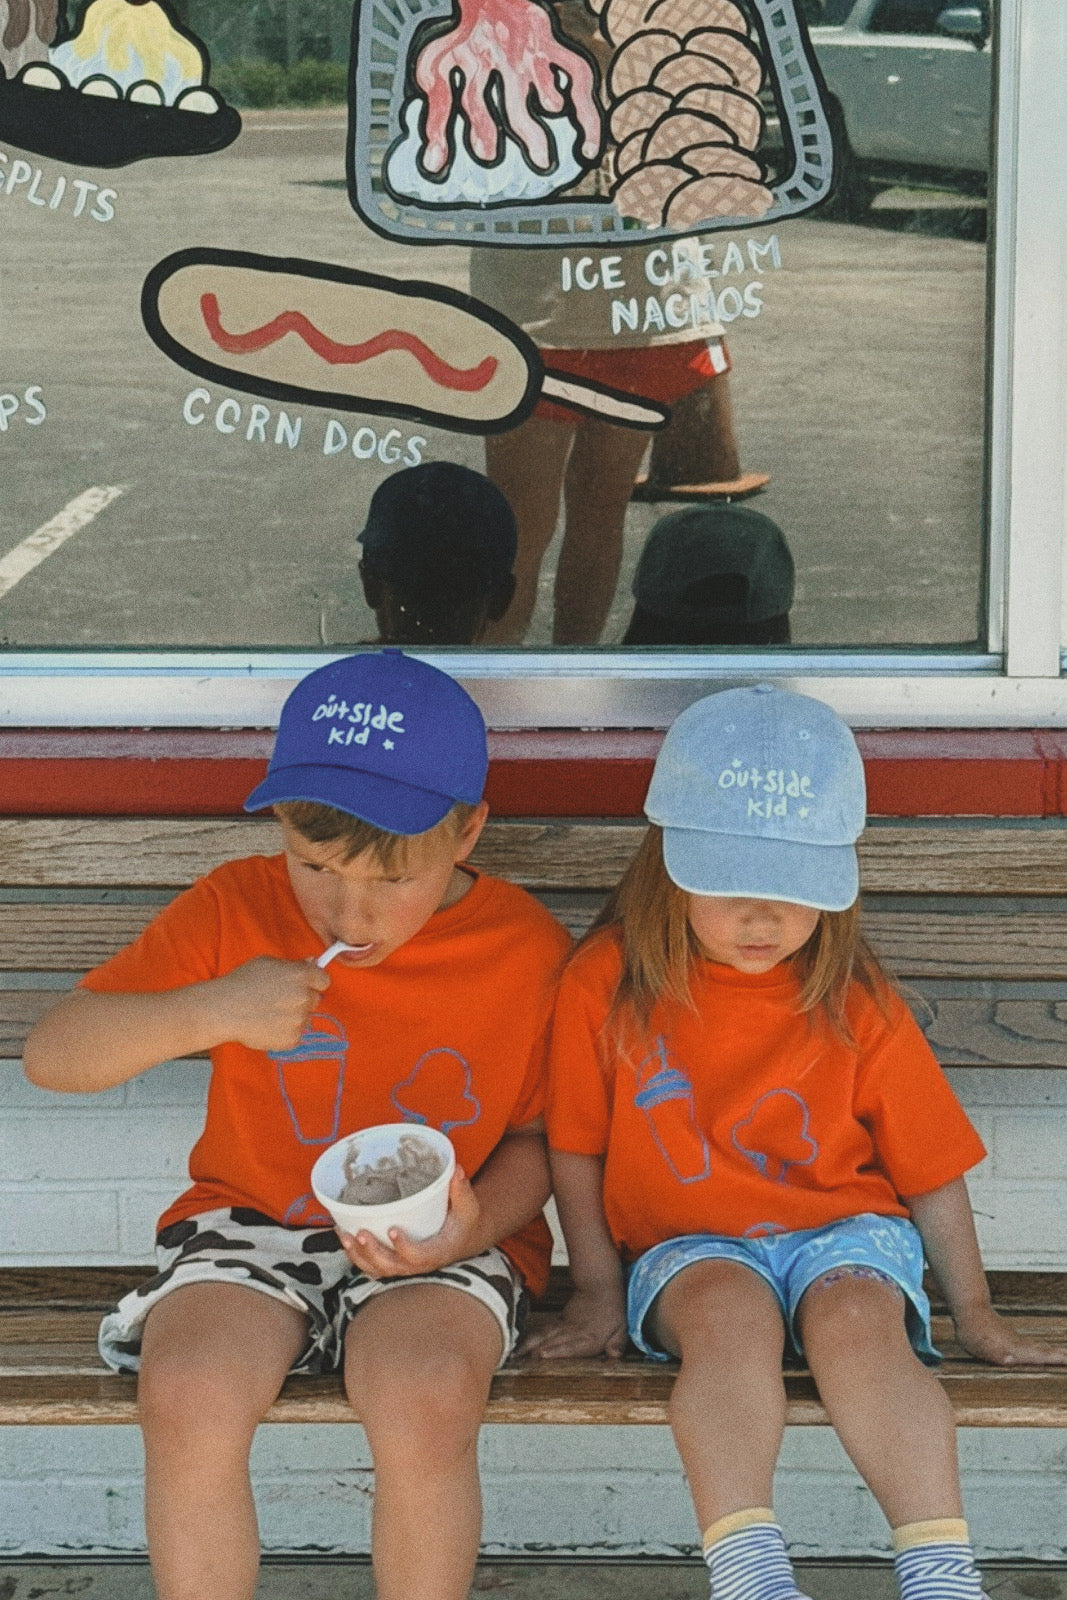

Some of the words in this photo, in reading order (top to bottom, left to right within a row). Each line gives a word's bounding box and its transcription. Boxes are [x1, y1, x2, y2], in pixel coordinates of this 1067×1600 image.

[561, 256, 626, 292] ICE
[645, 234, 782, 287] CREAM
[611, 281, 764, 335] NACHOS
[183, 387, 301, 449] CORN
[323, 420, 427, 467] DOGS
